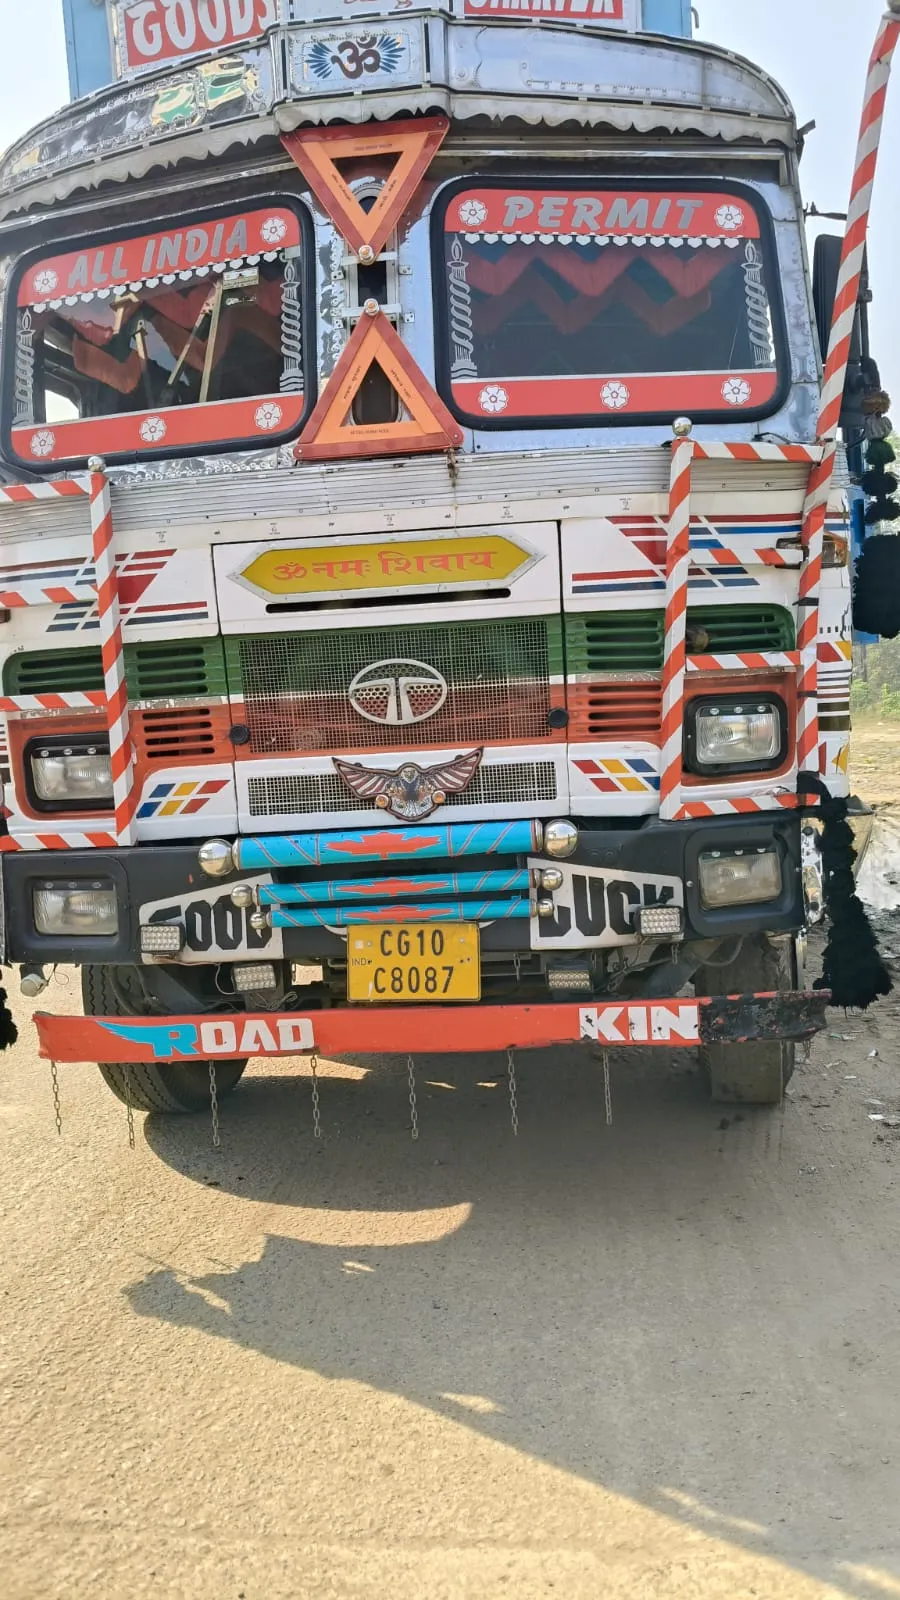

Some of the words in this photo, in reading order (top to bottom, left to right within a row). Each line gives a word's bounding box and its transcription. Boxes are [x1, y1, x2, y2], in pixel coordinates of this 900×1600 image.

[503, 196, 703, 230] PERMIT
[68, 247, 127, 288] ALL
[142, 219, 247, 273] INDIA
[273, 562, 307, 581] ॐ
[312, 560, 370, 579] नमः
[378, 551, 498, 576] शिवाय
[380, 929, 444, 956] CG10
[351, 957, 367, 966] IND
[374, 966, 454, 994] C8087
[95, 1018, 315, 1057] ROAD
[579, 1005, 699, 1041] KIN
